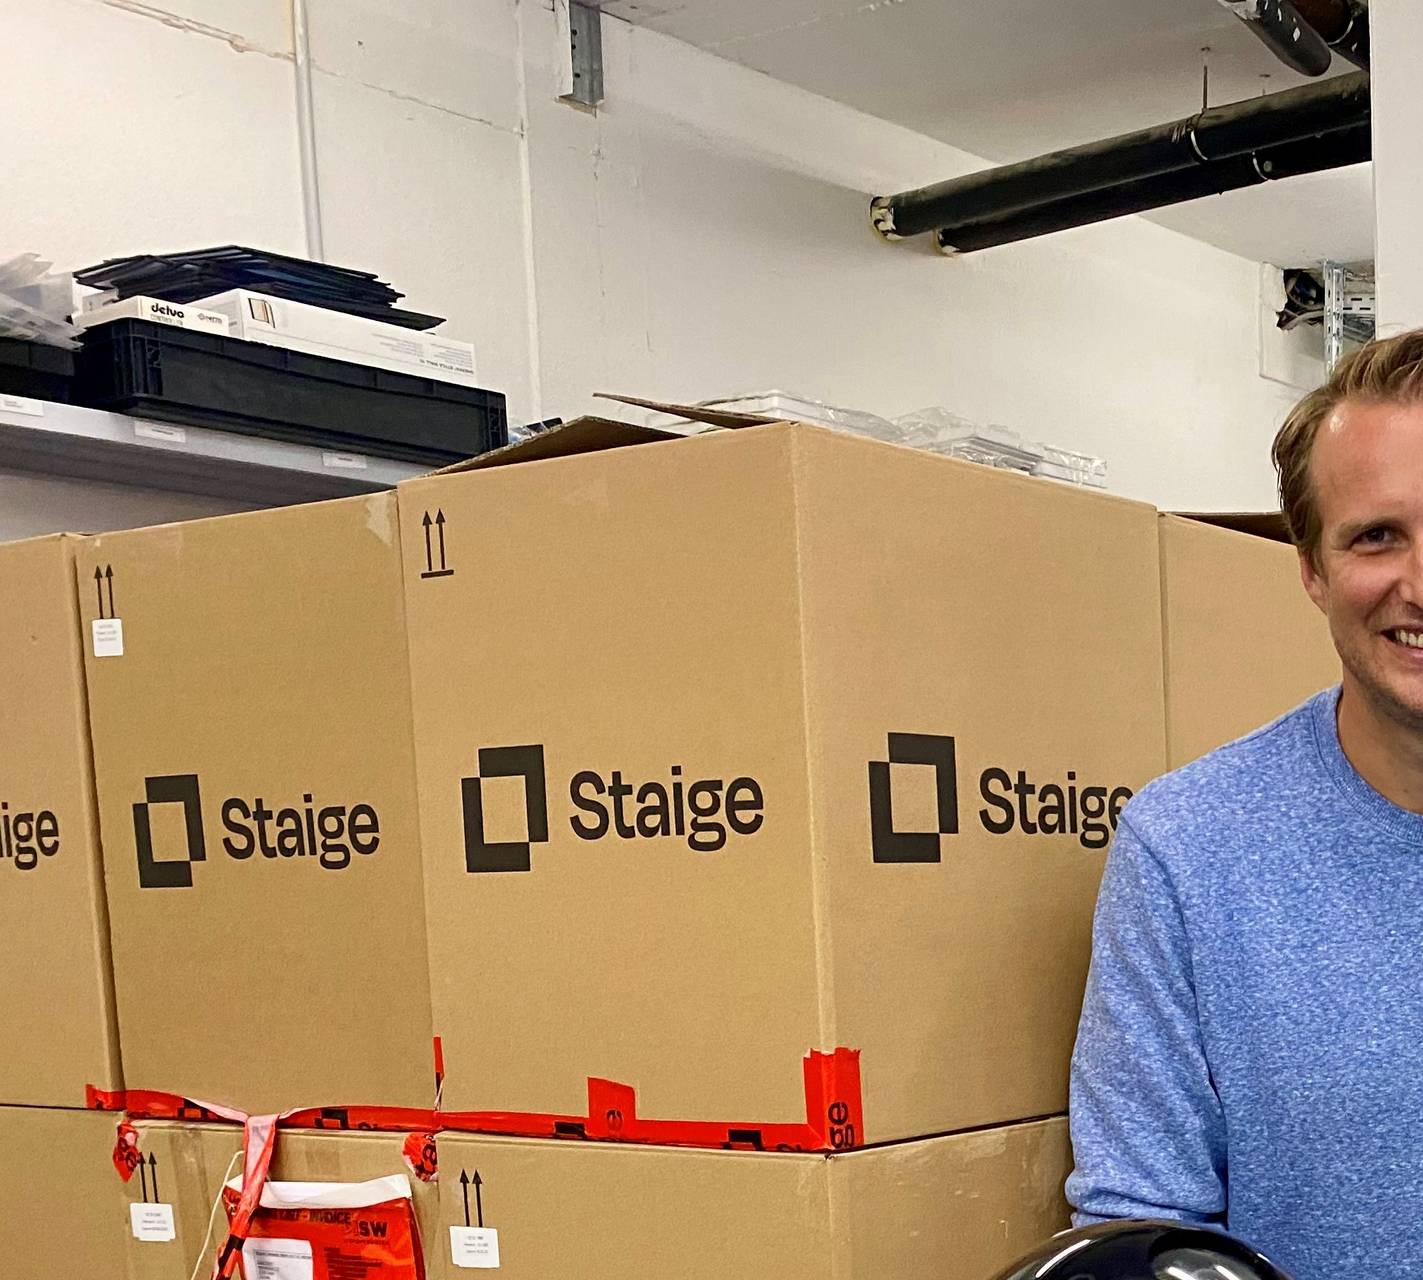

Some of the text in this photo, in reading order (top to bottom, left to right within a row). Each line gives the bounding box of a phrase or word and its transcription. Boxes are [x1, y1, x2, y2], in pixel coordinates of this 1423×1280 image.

[0, 802, 60, 870] ige
[221, 793, 380, 870] Staige
[570, 765, 764, 852] Staige
